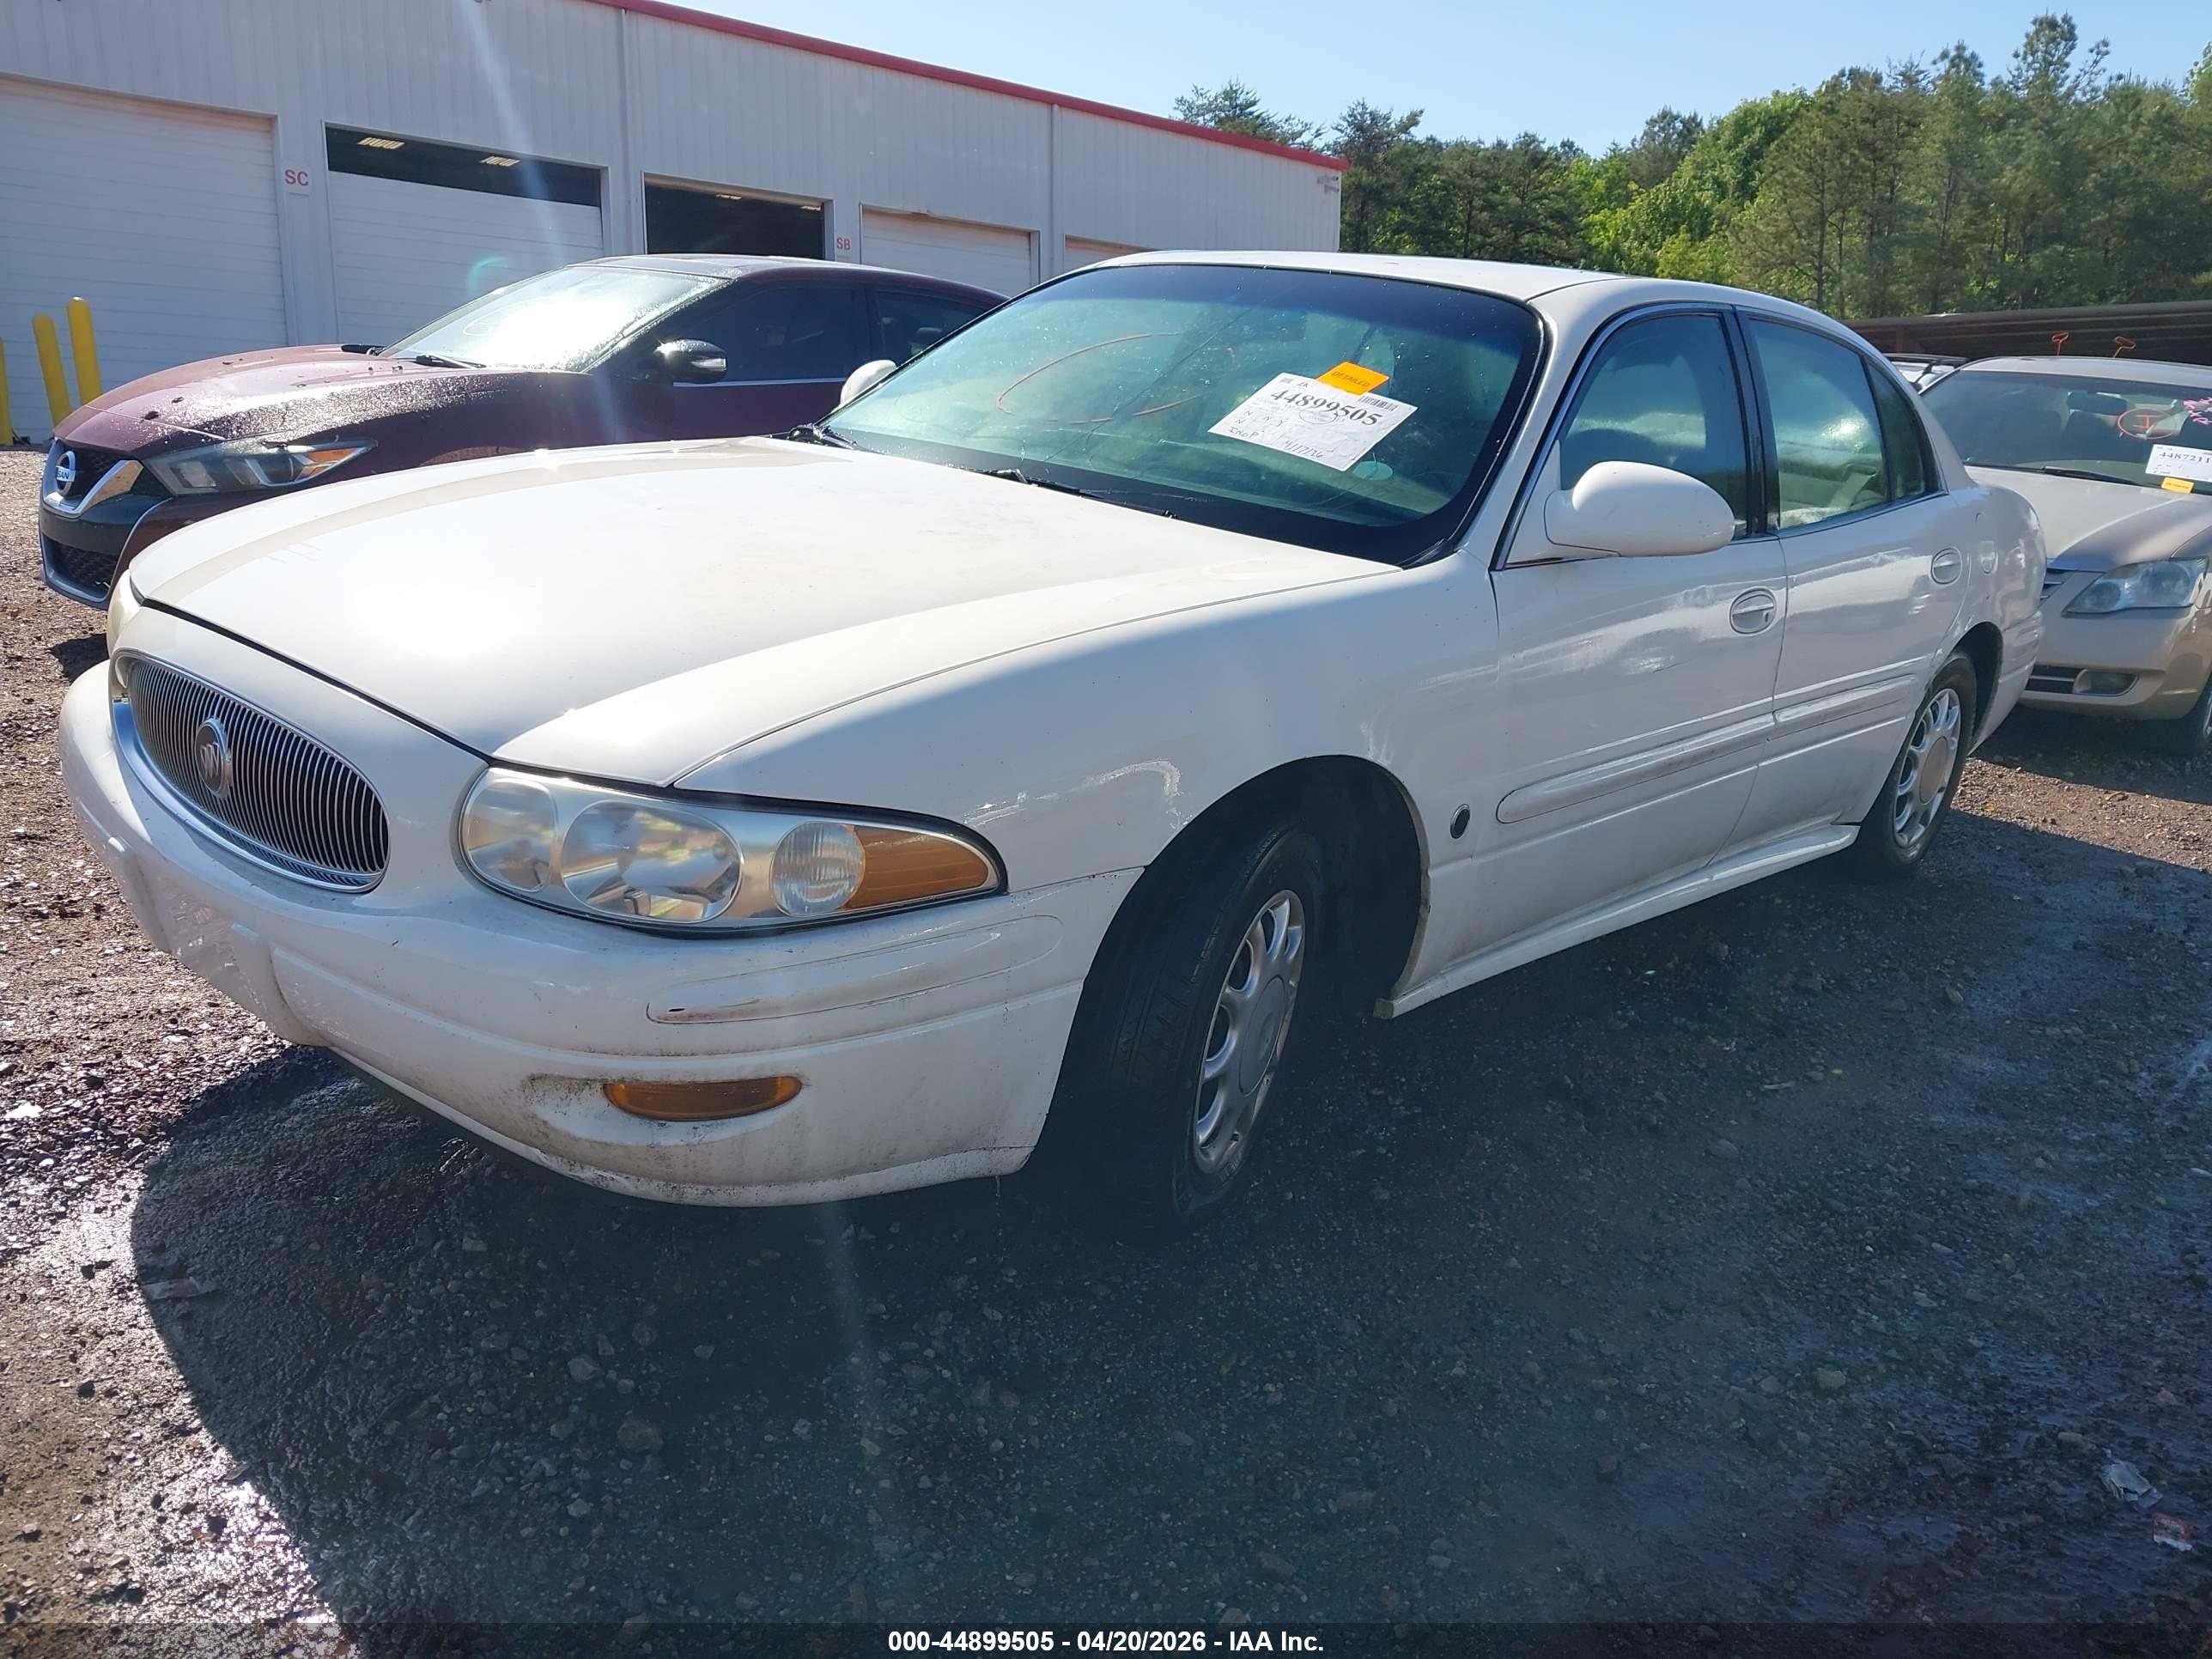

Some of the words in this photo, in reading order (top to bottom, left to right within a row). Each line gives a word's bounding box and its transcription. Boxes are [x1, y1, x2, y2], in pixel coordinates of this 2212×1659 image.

[284, 169, 308, 185] SC
[836, 238, 851, 250] SB
[1331, 371, 1370, 388] DETAILED
[1272, 390, 1382, 425] 44899505
[2159, 451, 2210, 463] 4487211
